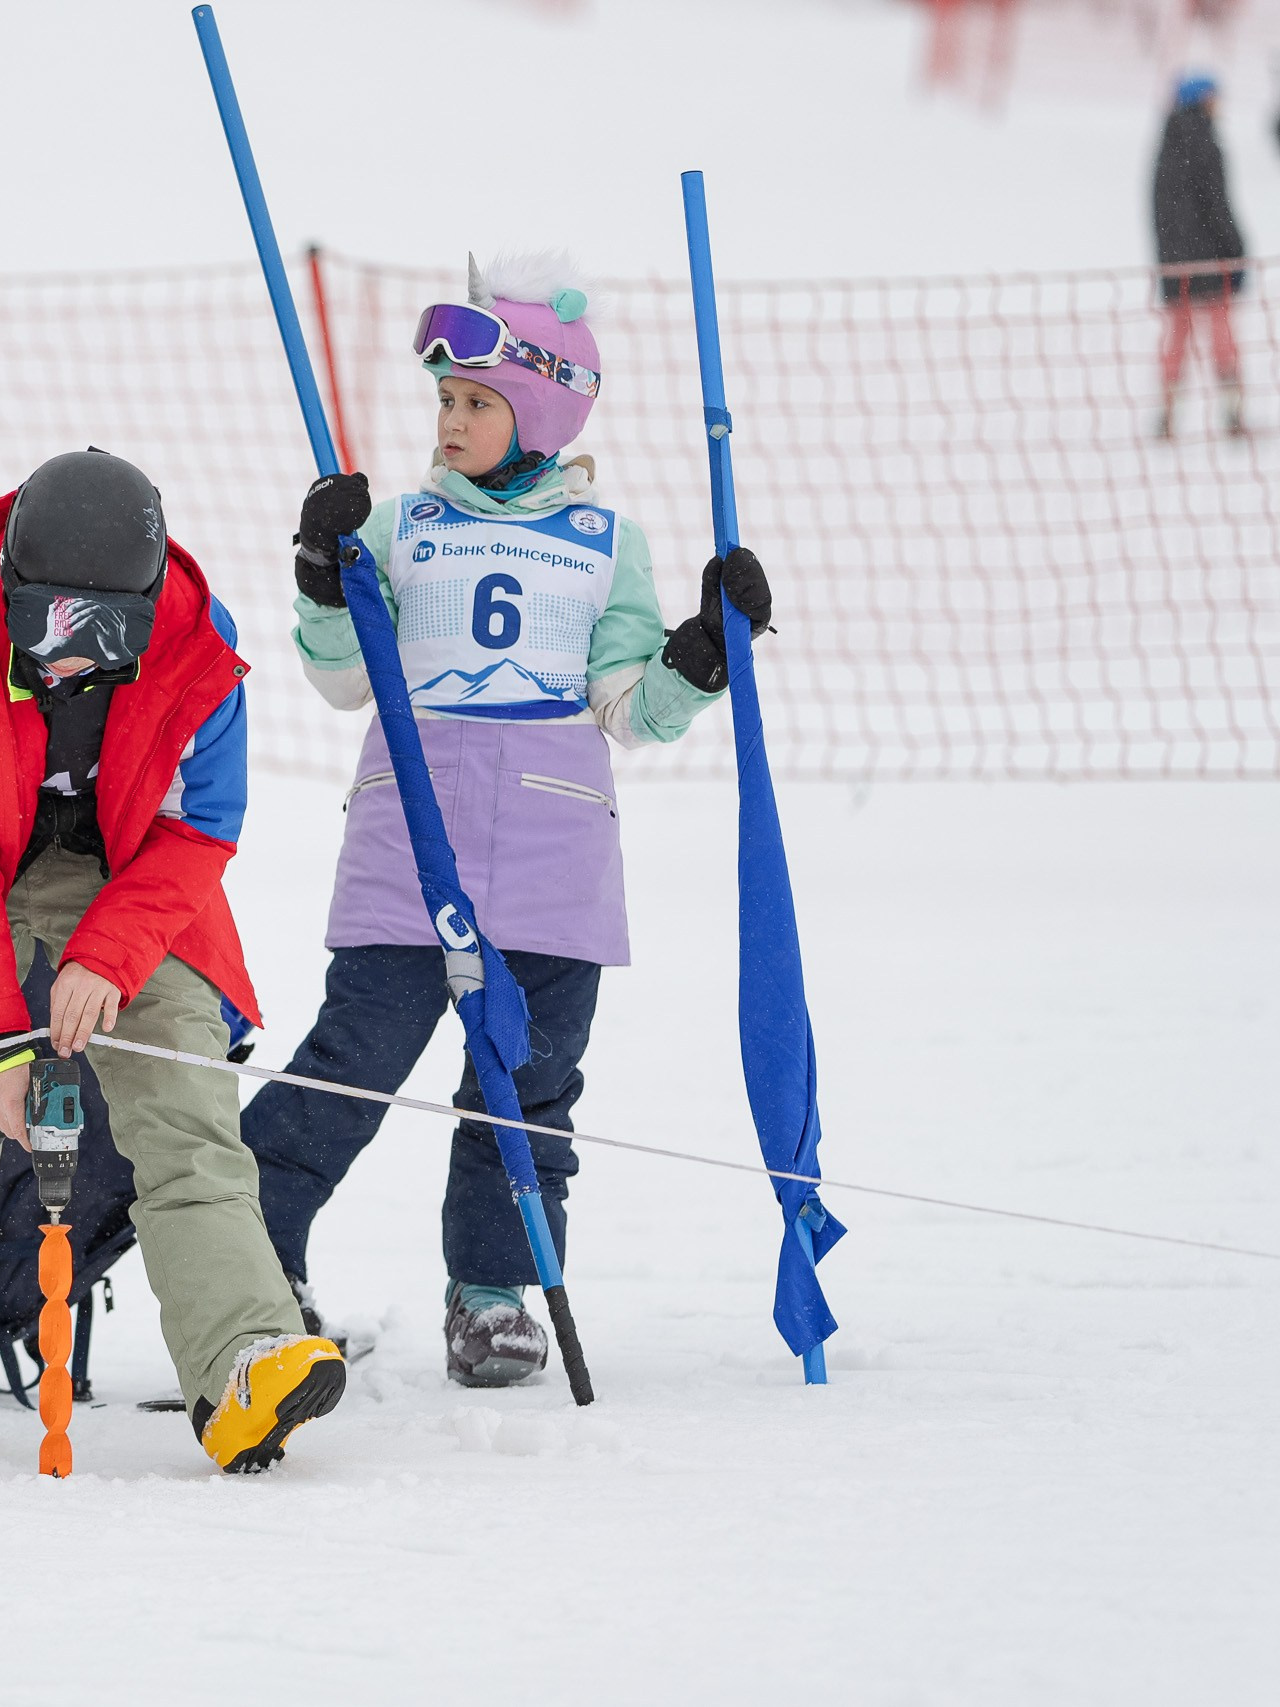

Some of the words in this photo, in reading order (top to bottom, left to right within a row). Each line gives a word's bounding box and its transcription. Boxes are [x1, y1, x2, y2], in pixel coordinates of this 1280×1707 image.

[441, 542, 486, 557] Банк
[490, 541, 596, 575] Финсервис
[471, 572, 523, 650] 6
[53, 628, 74, 637] CLUB
